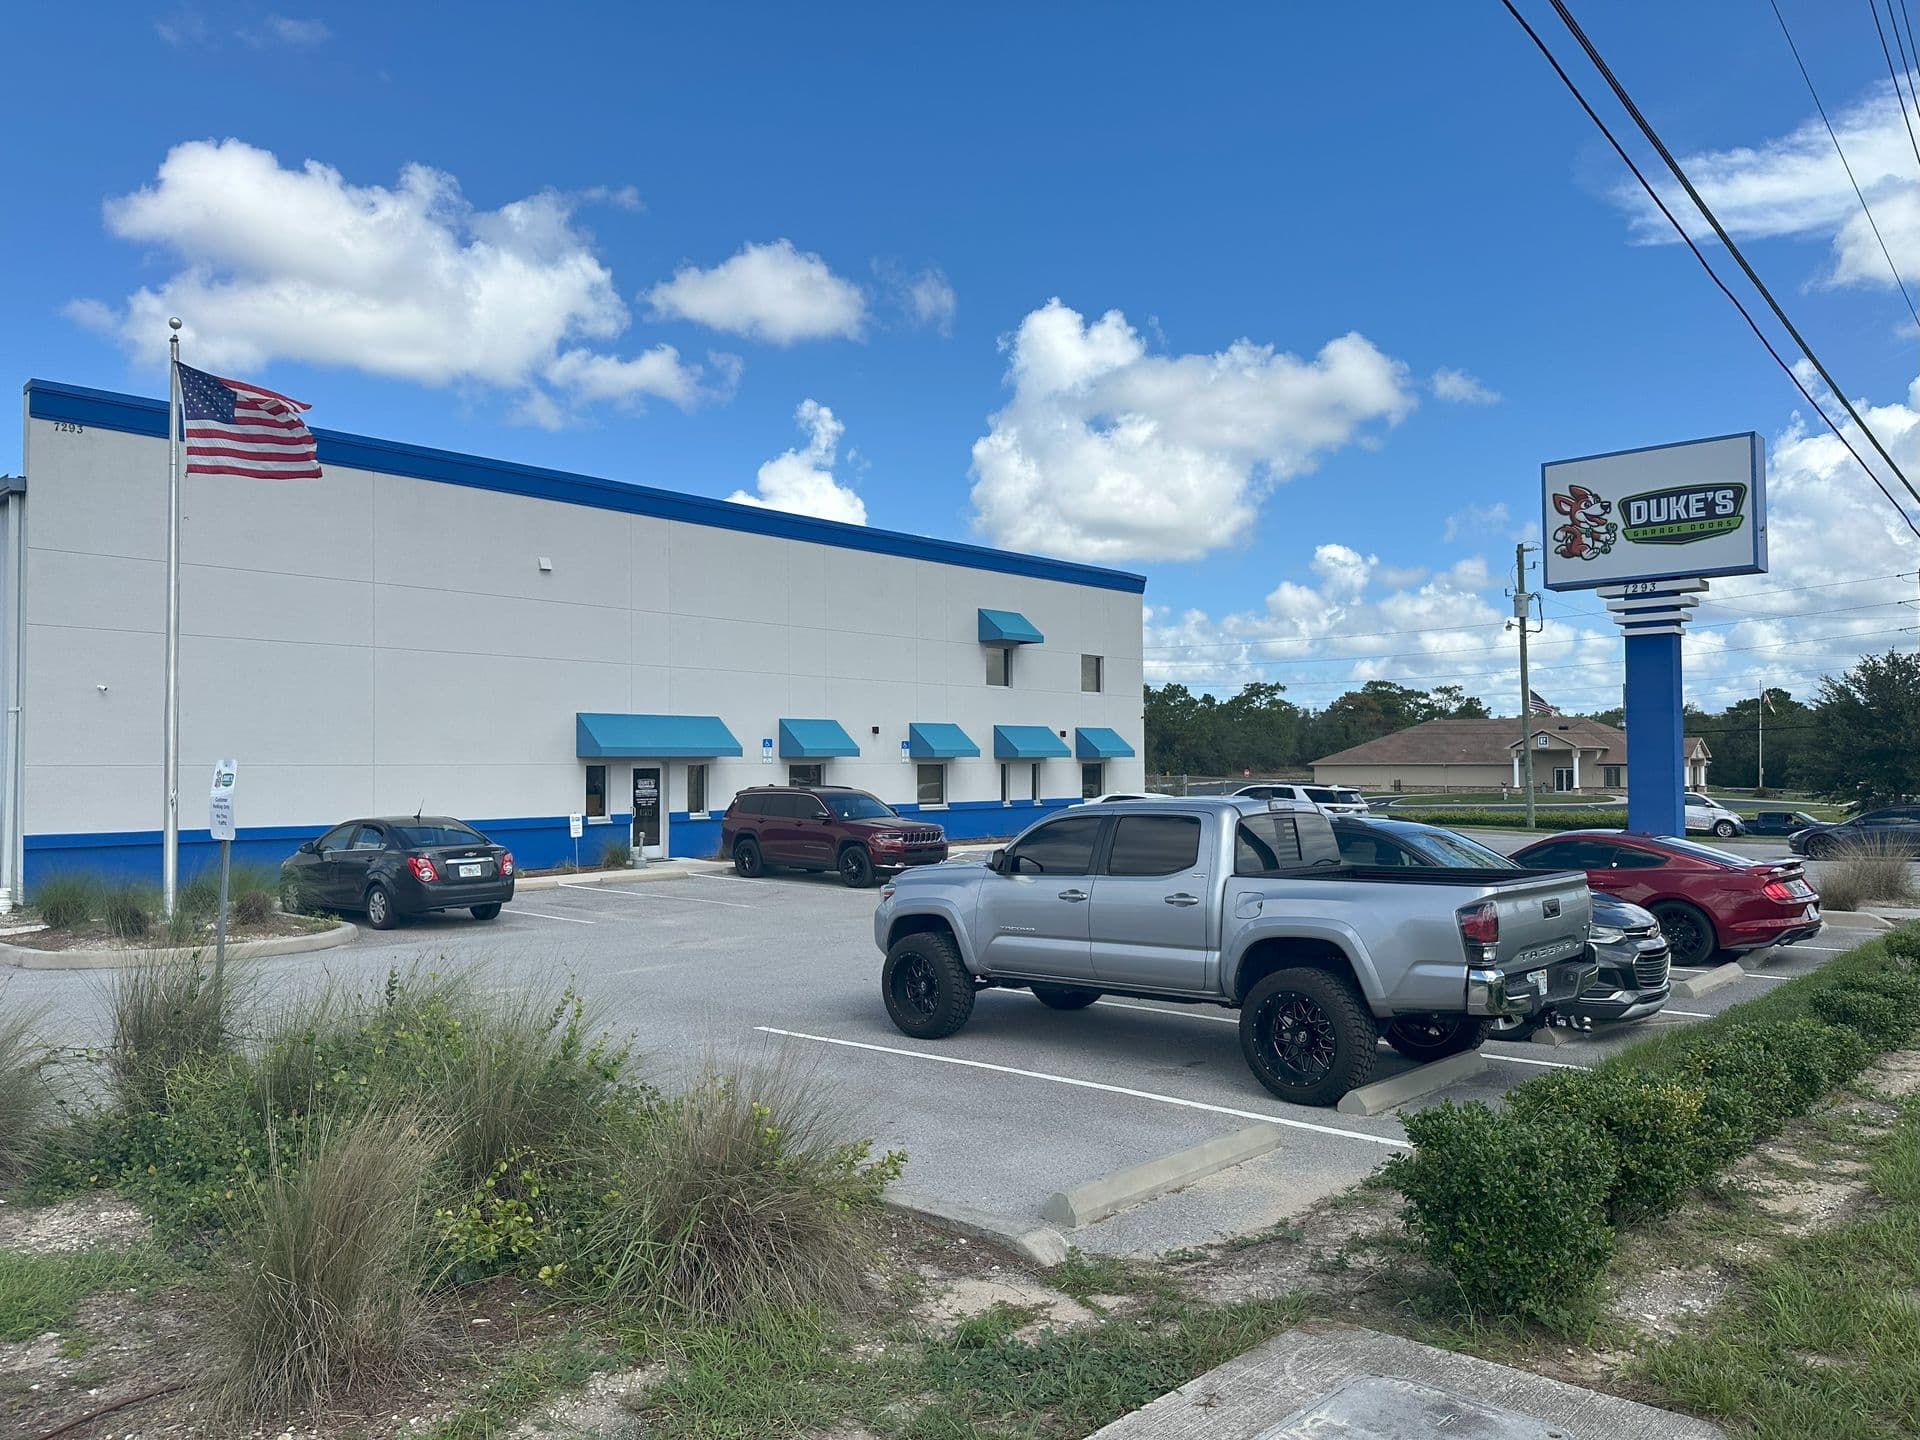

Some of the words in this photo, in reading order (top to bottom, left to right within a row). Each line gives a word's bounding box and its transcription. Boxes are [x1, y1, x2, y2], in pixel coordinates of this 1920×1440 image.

[54, 422, 84, 434] 7293
[1630, 489, 1735, 525] DUKE'S
[1633, 525, 1683, 537] GARAGE
[1690, 519, 1732, 531] DOORS
[1623, 582, 1656, 594] 7293
